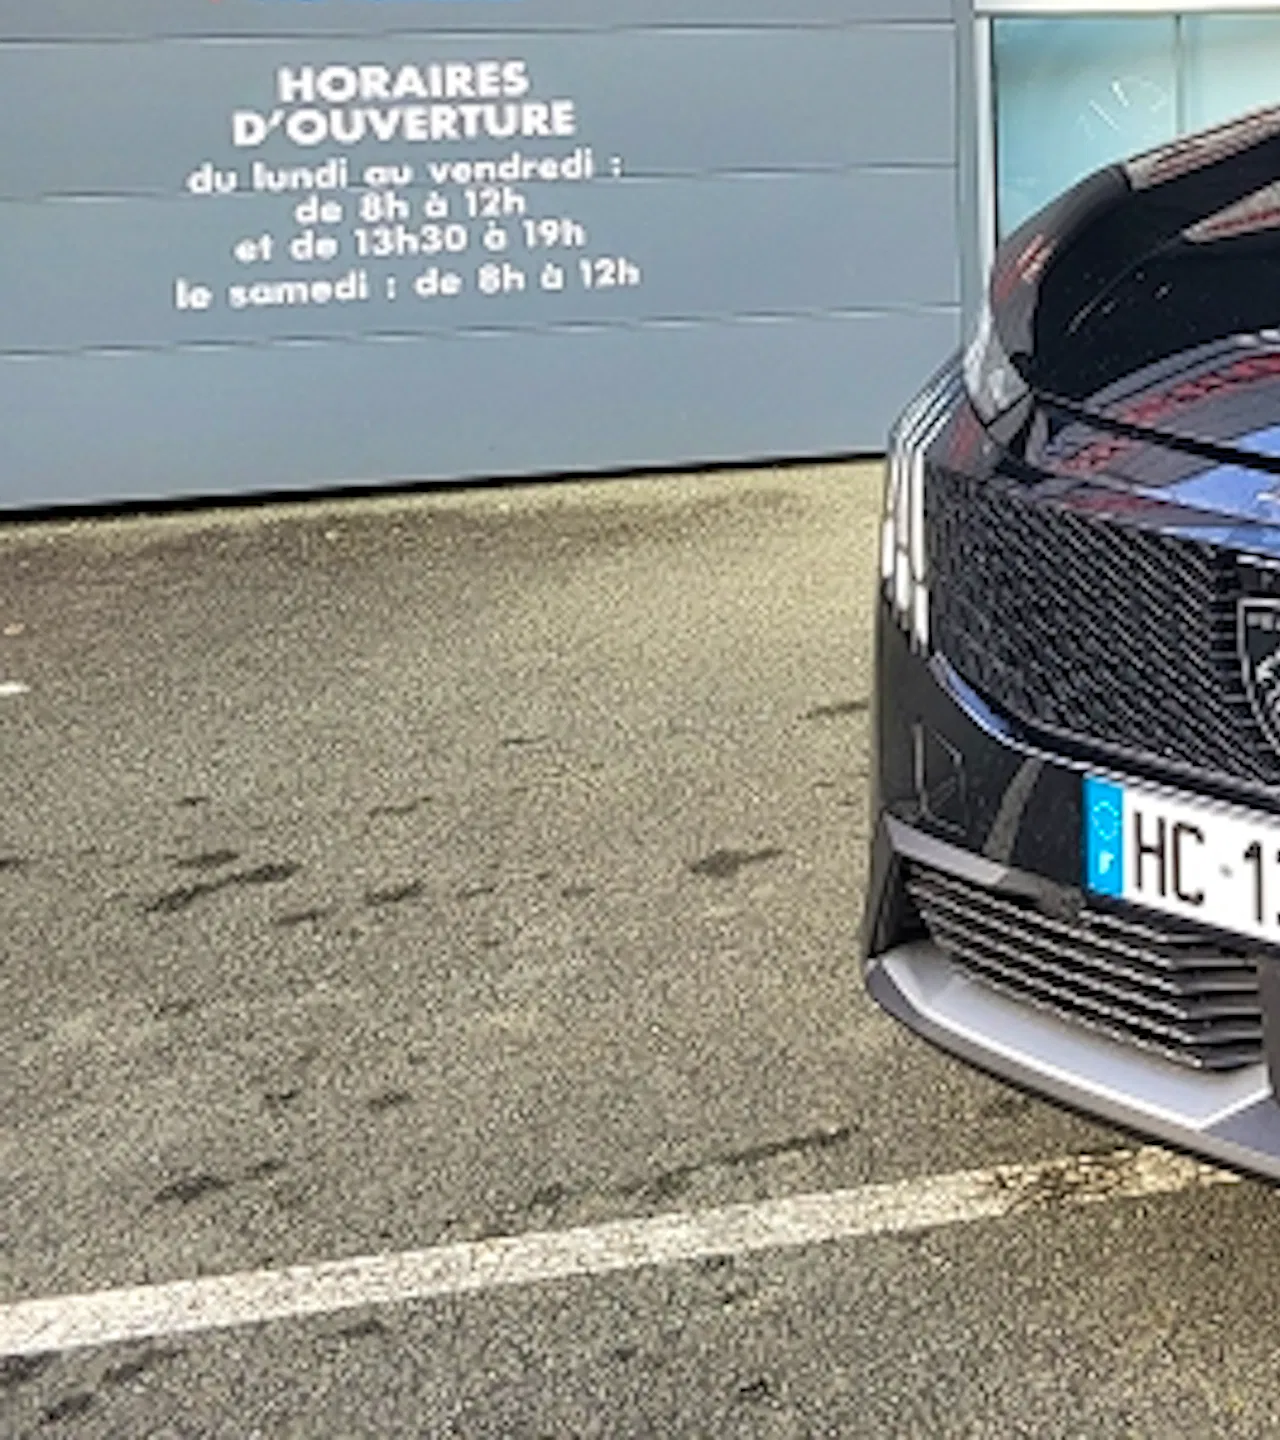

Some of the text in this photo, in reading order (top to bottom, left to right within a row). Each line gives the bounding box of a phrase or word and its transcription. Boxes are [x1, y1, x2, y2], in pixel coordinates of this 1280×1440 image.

[279, 61, 529, 102] HORAIRES
[232, 100, 577, 147] D'OUVERTURE
[187, 162, 237, 193] du
[253, 158, 349, 192] lundi
[364, 163, 412, 188] au
[430, 148, 593, 185] vendredi
[295, 187, 526, 223] de 8h à 12h
[234, 219, 587, 263] et de 13h30 à 19h
[175, 279, 213, 310] le
[229, 271, 368, 308] samedi
[414, 266, 462, 296] de
[478, 263, 525, 293] 8h
[540, 259, 565, 291] à
[580, 258, 640, 290] 12h
